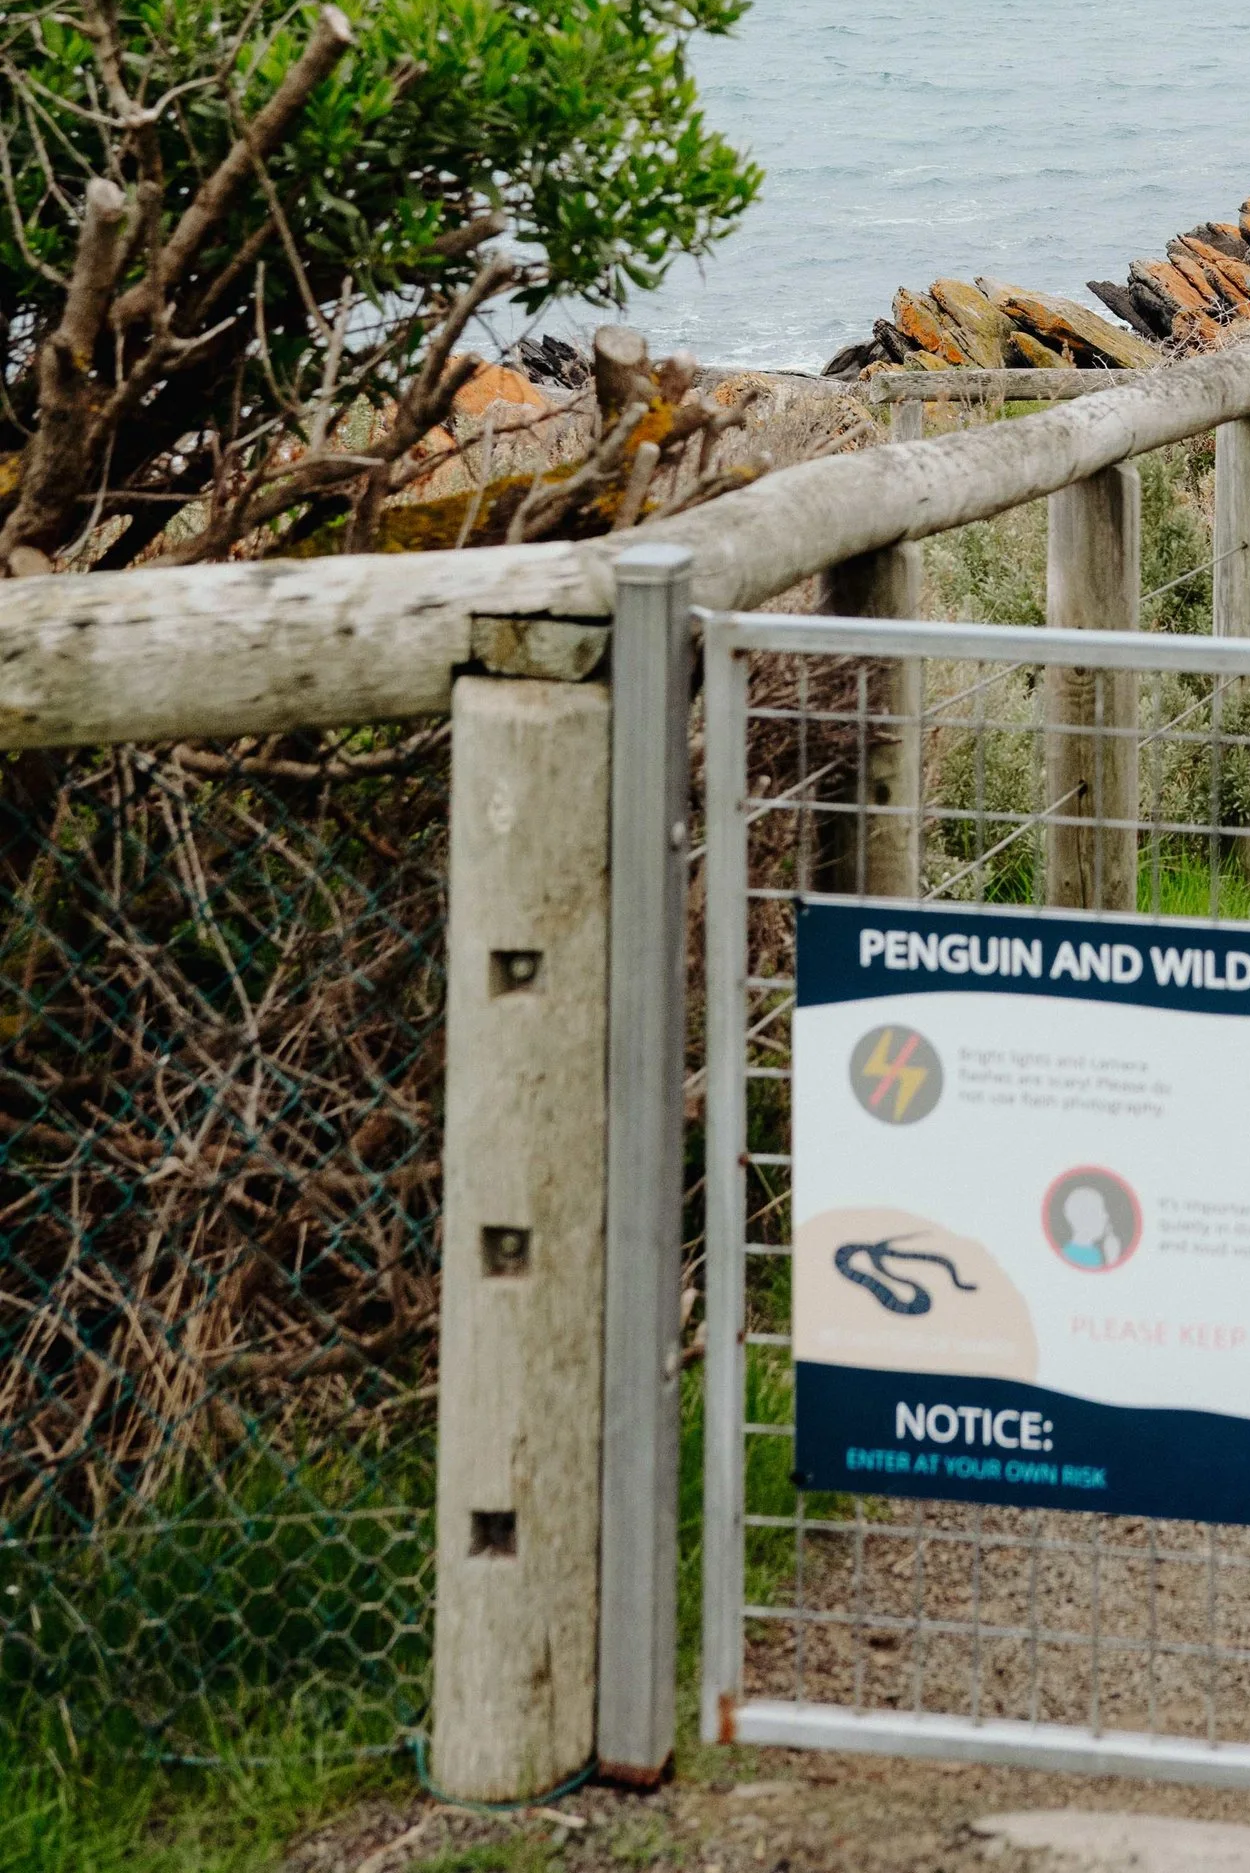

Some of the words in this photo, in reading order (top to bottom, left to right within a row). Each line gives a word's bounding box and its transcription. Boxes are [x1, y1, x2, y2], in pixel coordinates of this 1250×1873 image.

[860, 928, 1041, 978] PENGUIN
[1050, 941, 1143, 985] AND
[1017, 1074, 1042, 1086] are
[1055, 1054, 1086, 1069] and
[1158, 1238, 1188, 1254] and
[1071, 1315, 1167, 1346] PLEASE
[1179, 1321, 1247, 1352] KEEP
[895, 1401, 1054, 1452] NOTICE:
[846, 1446, 911, 1474] ENTER
[913, 1452, 941, 1475] AT
[944, 1453, 1002, 1480] YOUR
[1004, 1459, 1059, 1486] OWN
[1061, 1464, 1107, 1490] RISK
